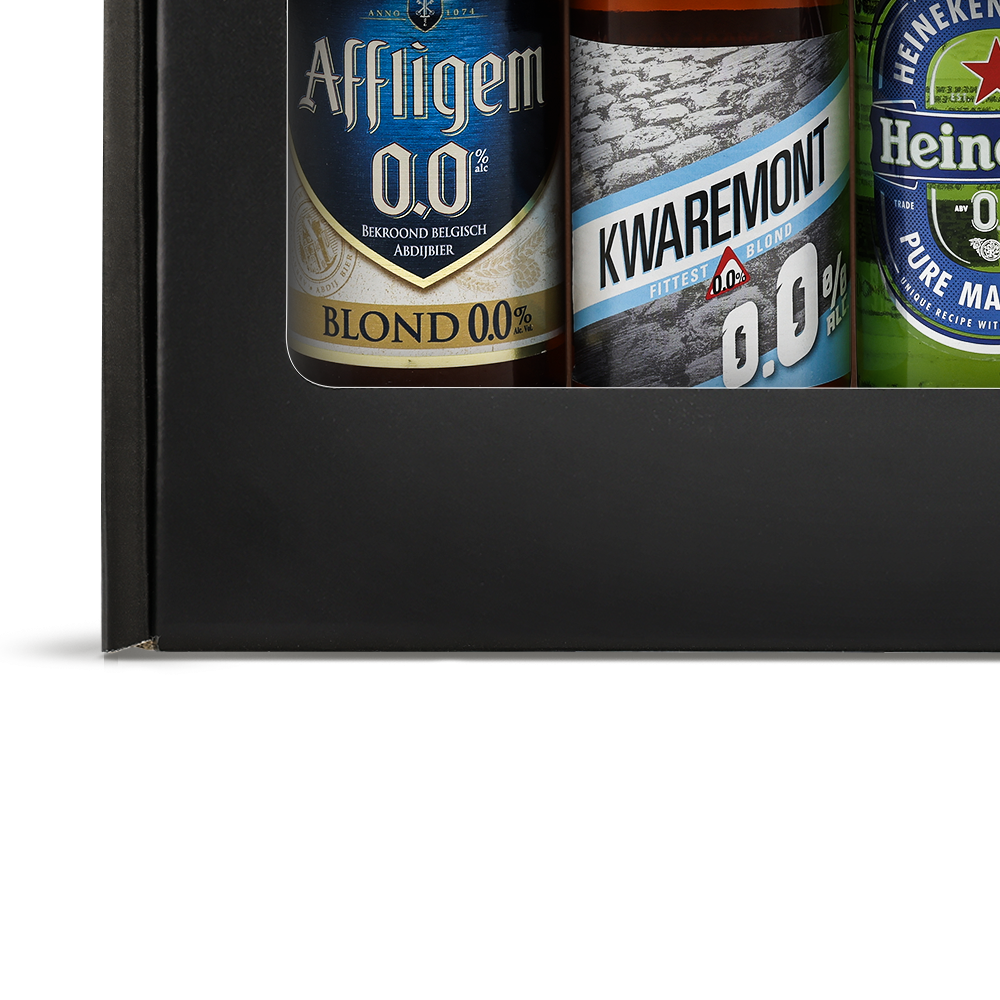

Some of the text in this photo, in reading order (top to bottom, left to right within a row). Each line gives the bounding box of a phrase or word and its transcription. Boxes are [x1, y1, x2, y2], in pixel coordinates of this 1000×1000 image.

[368, 8, 476, 18] ANNO 1074
[298, 36, 546, 136] Affligem
[950, 92, 970, 102] EST.
[474, 164, 488, 173] alc
[600, 117, 830, 290] KWAREMONT
[894, 200, 915, 210] TRADE
[362, 224, 487, 239] BEKROOND BELGISCH
[394, 244, 455, 259] ABDIJBIER
[650, 222, 793, 299] FITTEST BLOND
[340, 254, 353, 278] BIER
[900, 232, 953, 297] PURE
[712, 269, 747, 295] 0.0%
[901, 277, 931, 312] UNIQUE
[936, 308, 973, 328] RECIPE
[322, 305, 460, 343] BLOND
